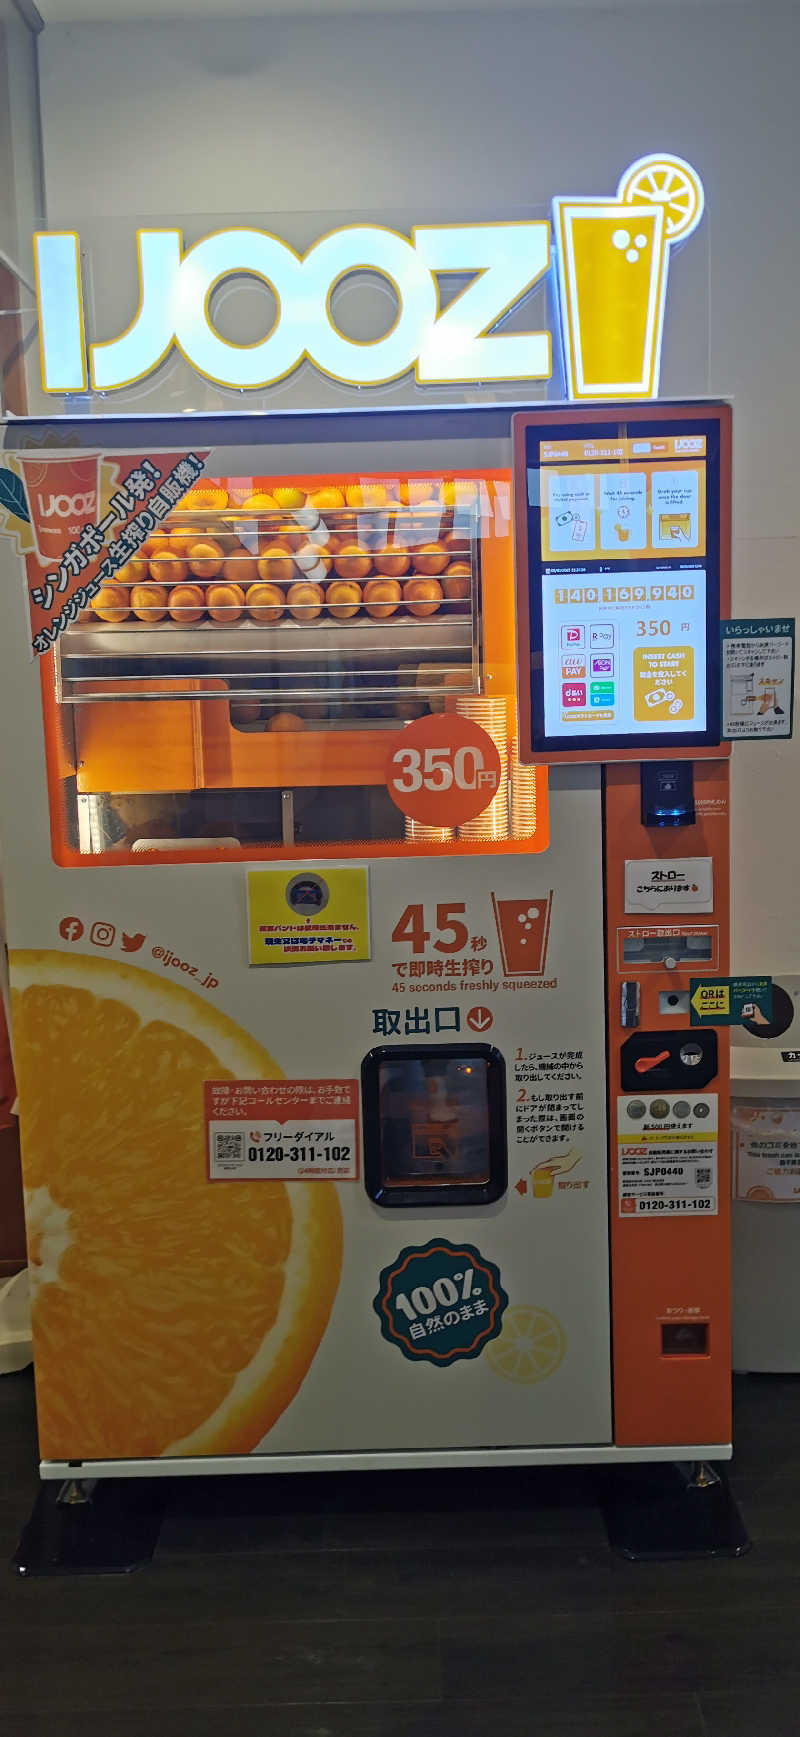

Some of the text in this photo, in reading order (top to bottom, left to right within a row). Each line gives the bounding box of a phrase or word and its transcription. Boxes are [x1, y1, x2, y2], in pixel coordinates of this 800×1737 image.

[33, 221, 551, 393] IJOOZ
[37, 490, 96, 518] IJOOZ
[637, 620, 671, 636] 350
[566, 667, 582, 675] PAY
[392, 746, 497, 793] 350円
[651, 870, 686, 880] ストロー
[151, 946, 219, 989] @ijooz_jp
[391, 959, 494, 978] で即時生搾り
[392, 978, 558, 993] 45 seconds freshly squeezed
[700, 989, 725, 1000] QRは
[372, 1006, 461, 1036] 取出口
[248, 1146, 351, 1161] 0120-311-102
[639, 1199, 711, 1210] 0120-311-102
[395, 1268, 483, 1321] 100%
[408, 1299, 490, 1340] 自然のまま
